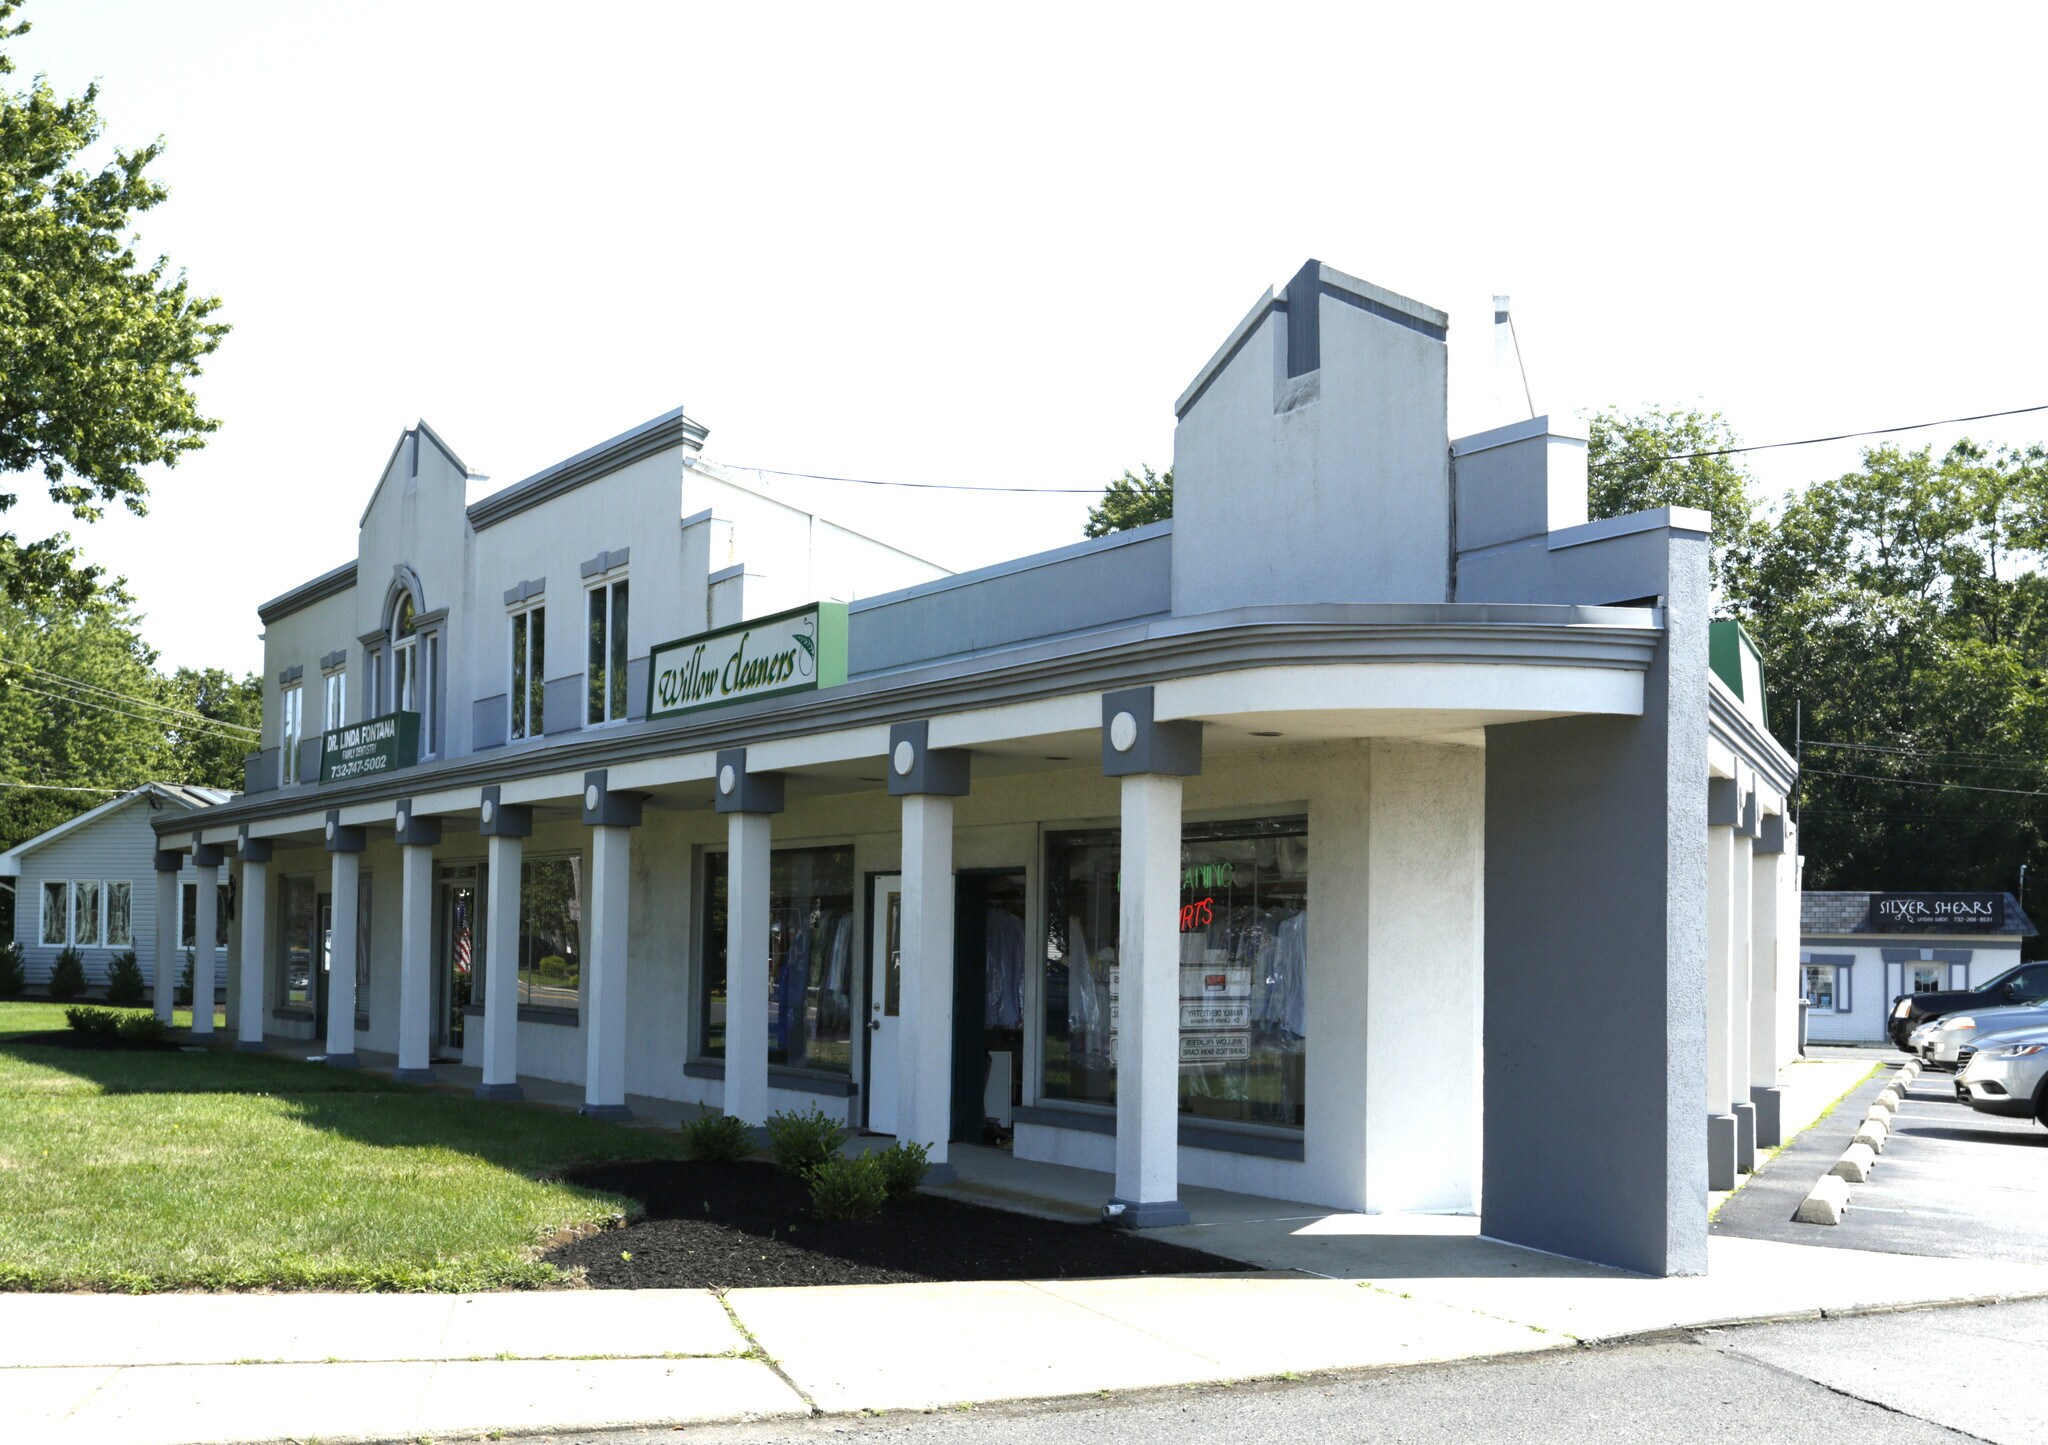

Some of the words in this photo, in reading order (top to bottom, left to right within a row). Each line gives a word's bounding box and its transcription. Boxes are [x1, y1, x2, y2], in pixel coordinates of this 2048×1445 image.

[658, 644, 718, 708] Willow
[721, 631, 797, 696] Cleaners
[327, 734, 339, 753] DR.
[340, 728, 360, 749] LINDA
[361, 719, 395, 744] FONTANA
[355, 743, 377, 758] DENTISTRY
[331, 755, 387, 779] 732-747-5002
[1934, 901, 1993, 915] SHEARS
